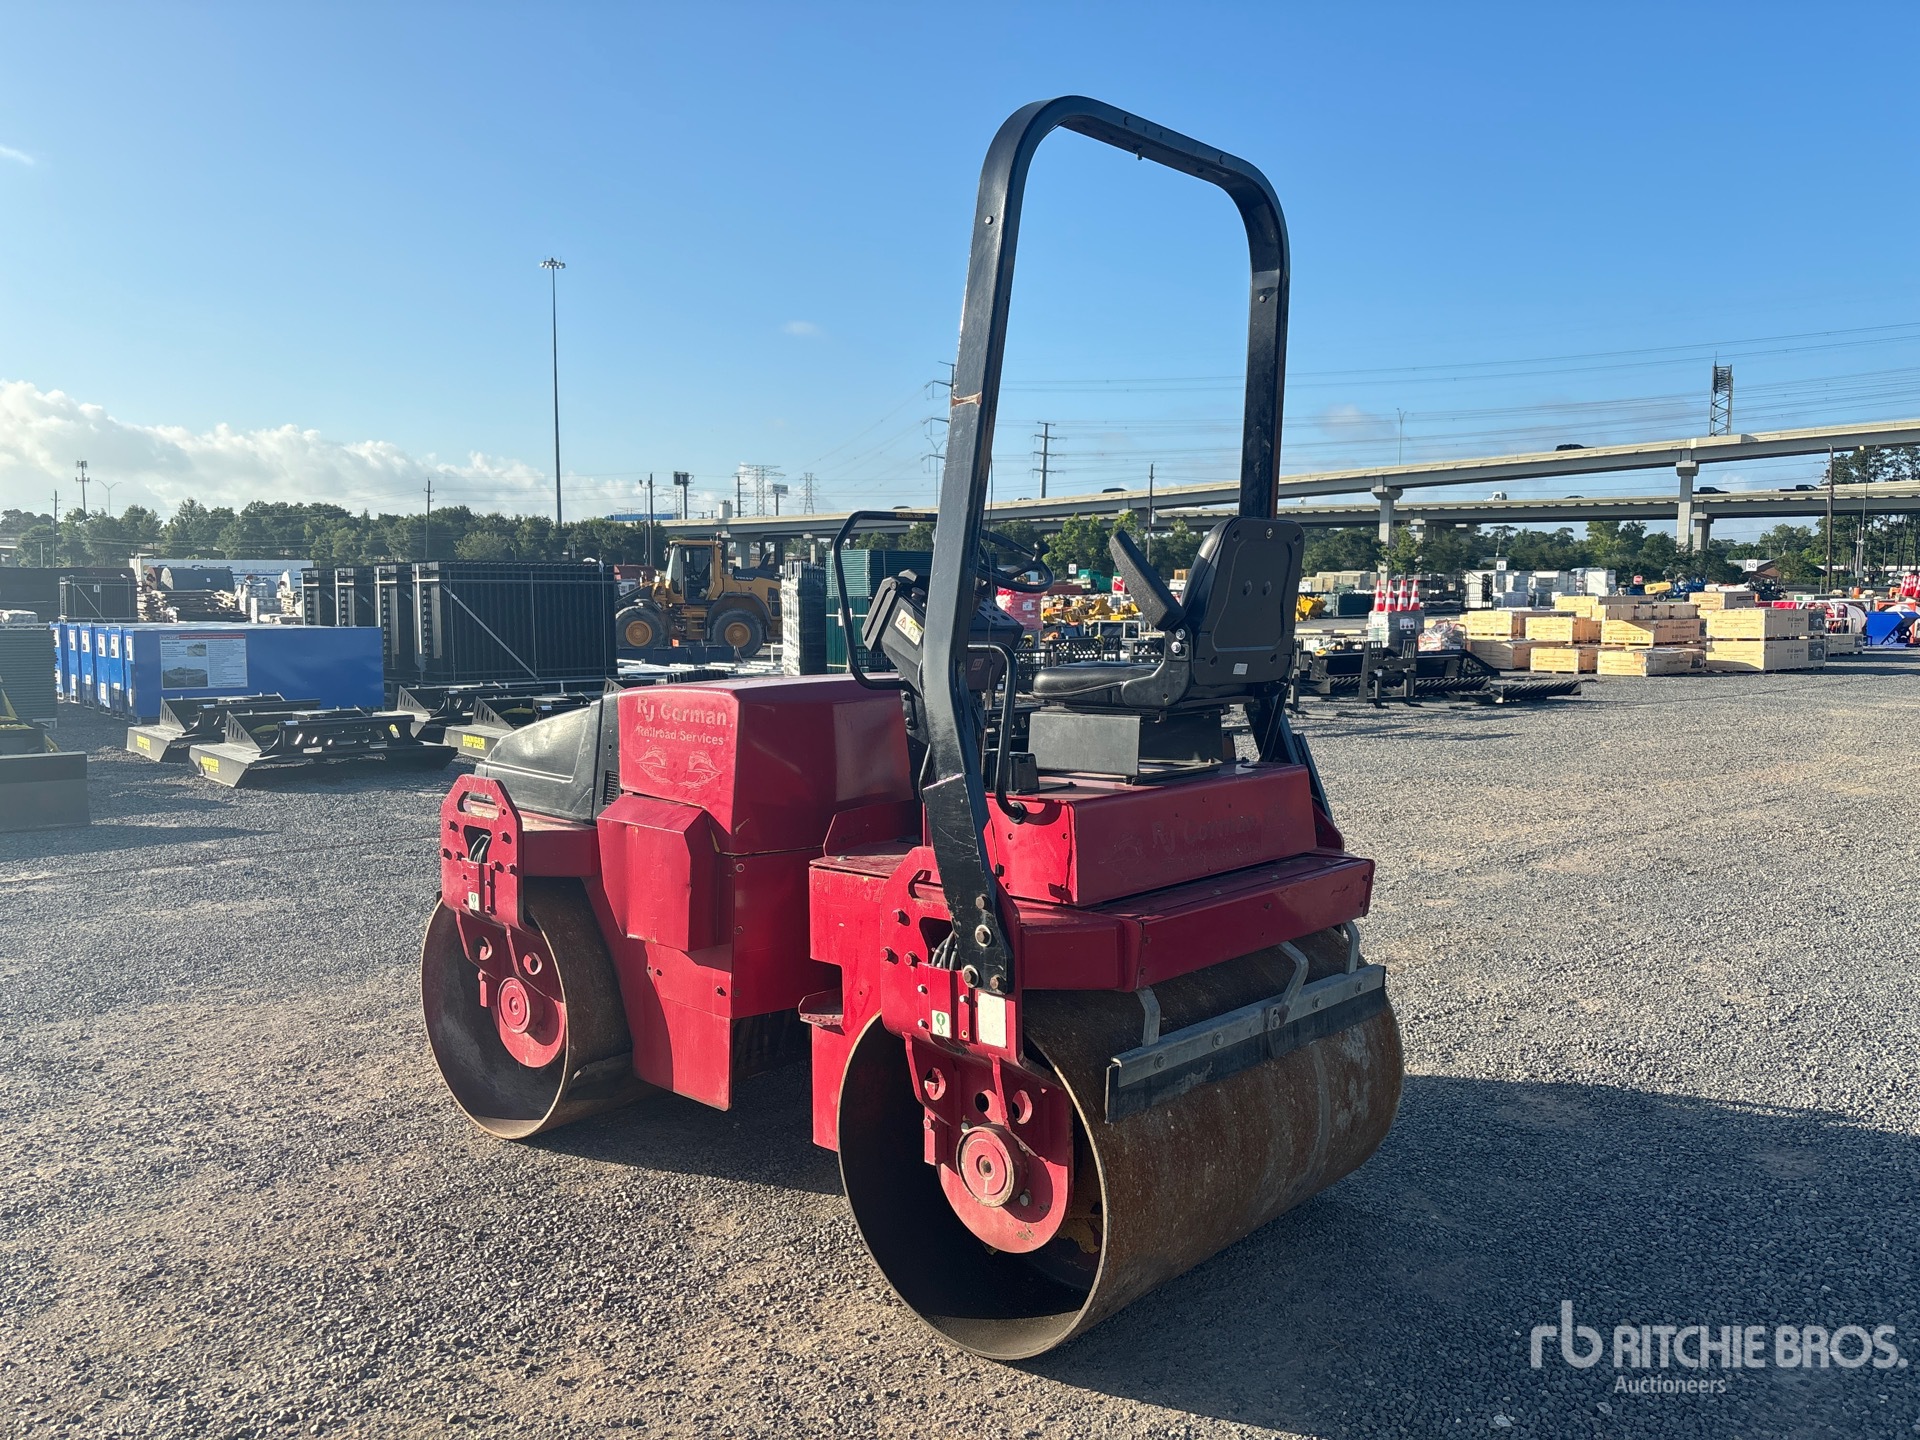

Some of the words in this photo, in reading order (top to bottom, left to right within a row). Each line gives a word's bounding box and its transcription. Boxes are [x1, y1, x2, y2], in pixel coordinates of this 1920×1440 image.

[660, 702, 727, 726] Corman
[635, 725, 677, 740] Railroad
[679, 730, 724, 745] Services
